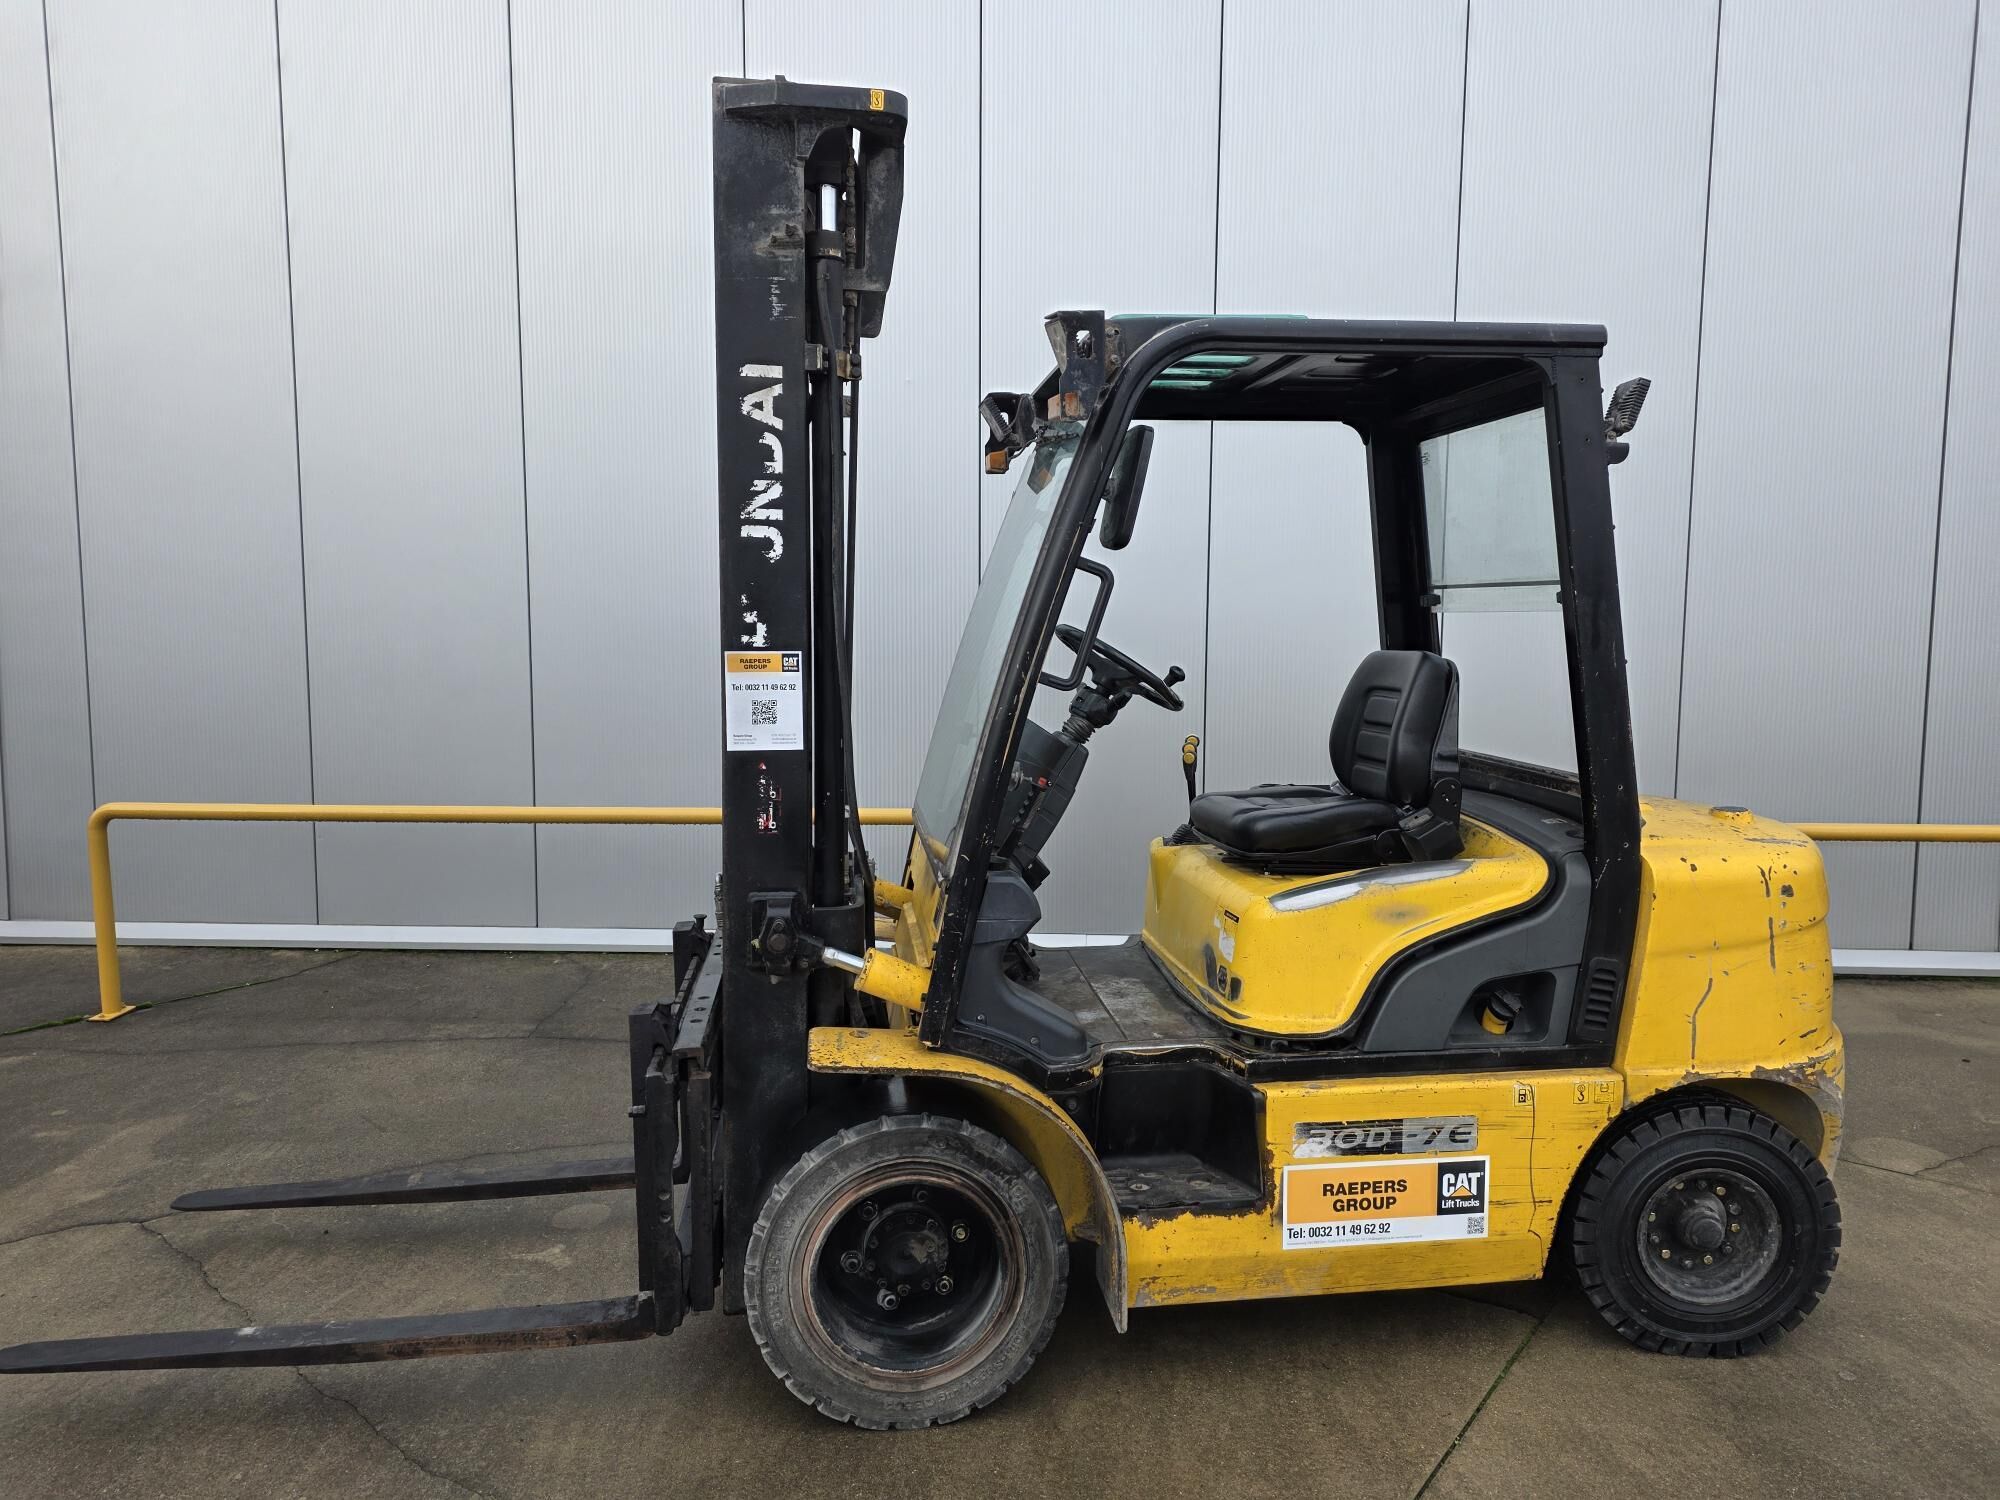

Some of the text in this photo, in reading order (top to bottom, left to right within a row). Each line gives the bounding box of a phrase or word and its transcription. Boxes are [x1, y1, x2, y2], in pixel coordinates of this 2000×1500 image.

[783, 657, 798, 666] CAT
[1323, 1179, 1408, 1197] RAEPERS
[1442, 1172, 1481, 1197] CAT
[1332, 1196, 1398, 1213] GROUP
[1441, 1198, 1480, 1209] Lift Trucks
[1287, 1222, 1391, 1239] Tel: 0032 11 49 62 92
